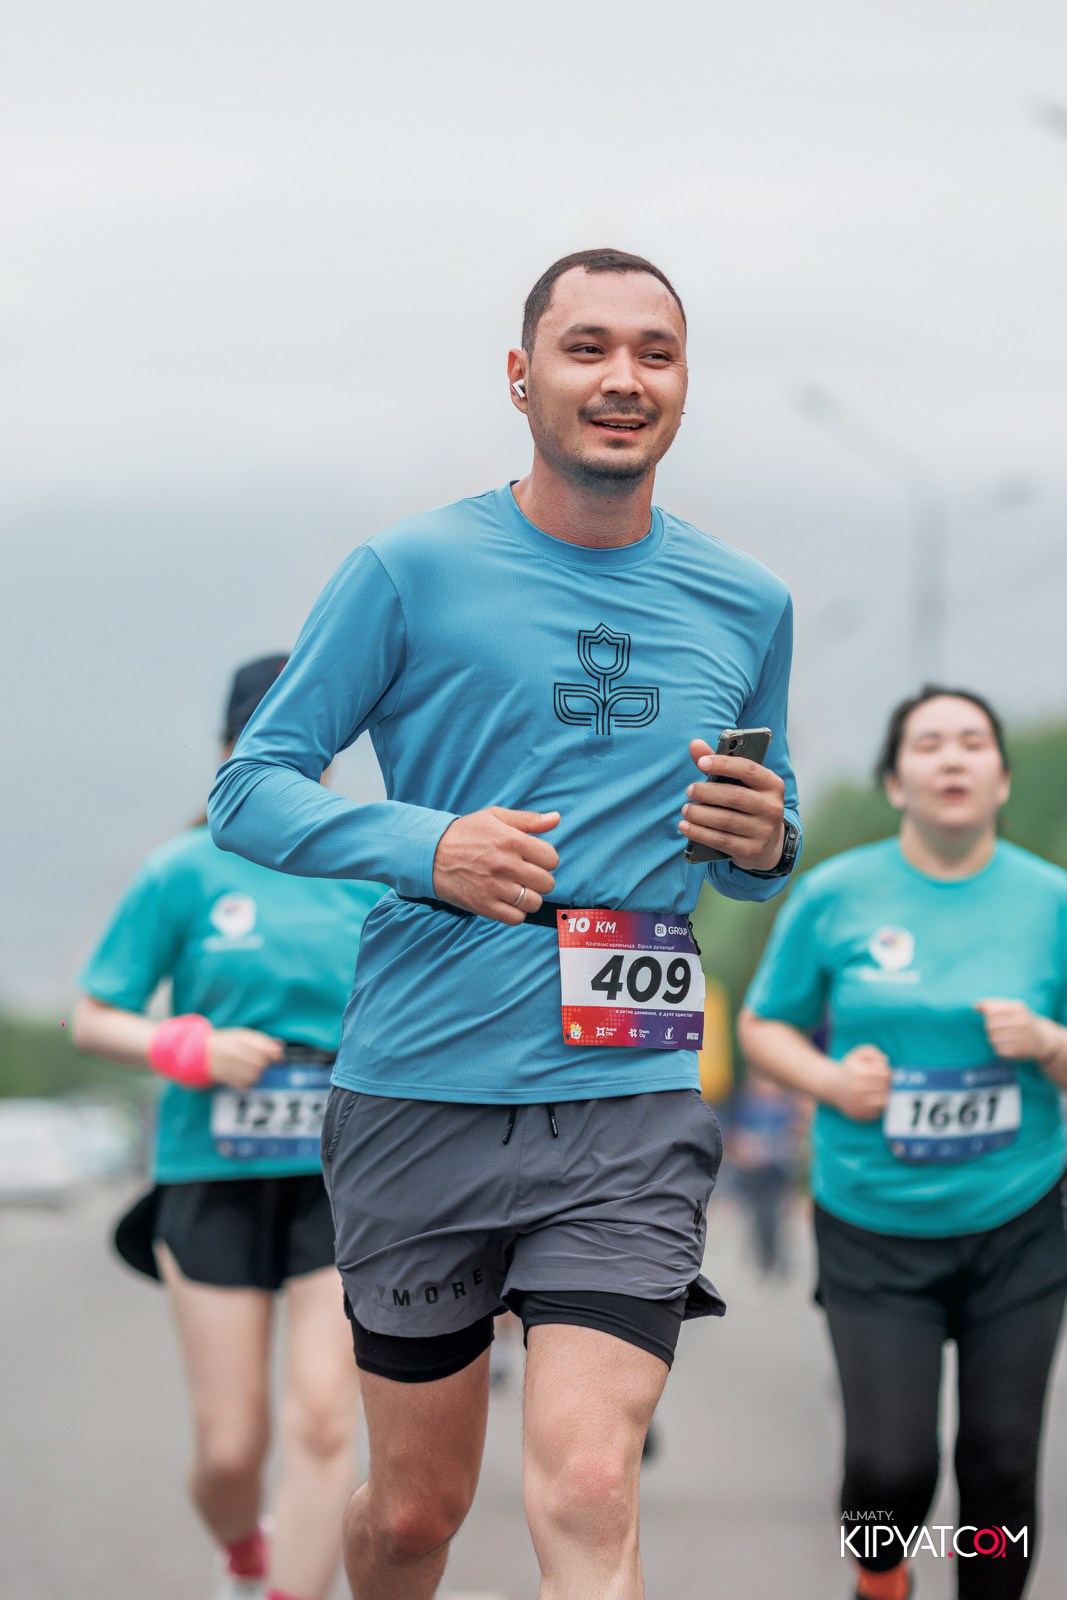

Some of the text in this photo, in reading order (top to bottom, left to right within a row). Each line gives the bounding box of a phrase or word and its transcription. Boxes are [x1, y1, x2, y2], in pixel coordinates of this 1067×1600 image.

[568, 917, 617, 934] 10 KM
[667, 926, 688, 936] GROUP
[590, 954, 692, 1004] 409
[910, 1093, 1000, 1130] 1661
[392, 1268, 483, 1306] MORE
